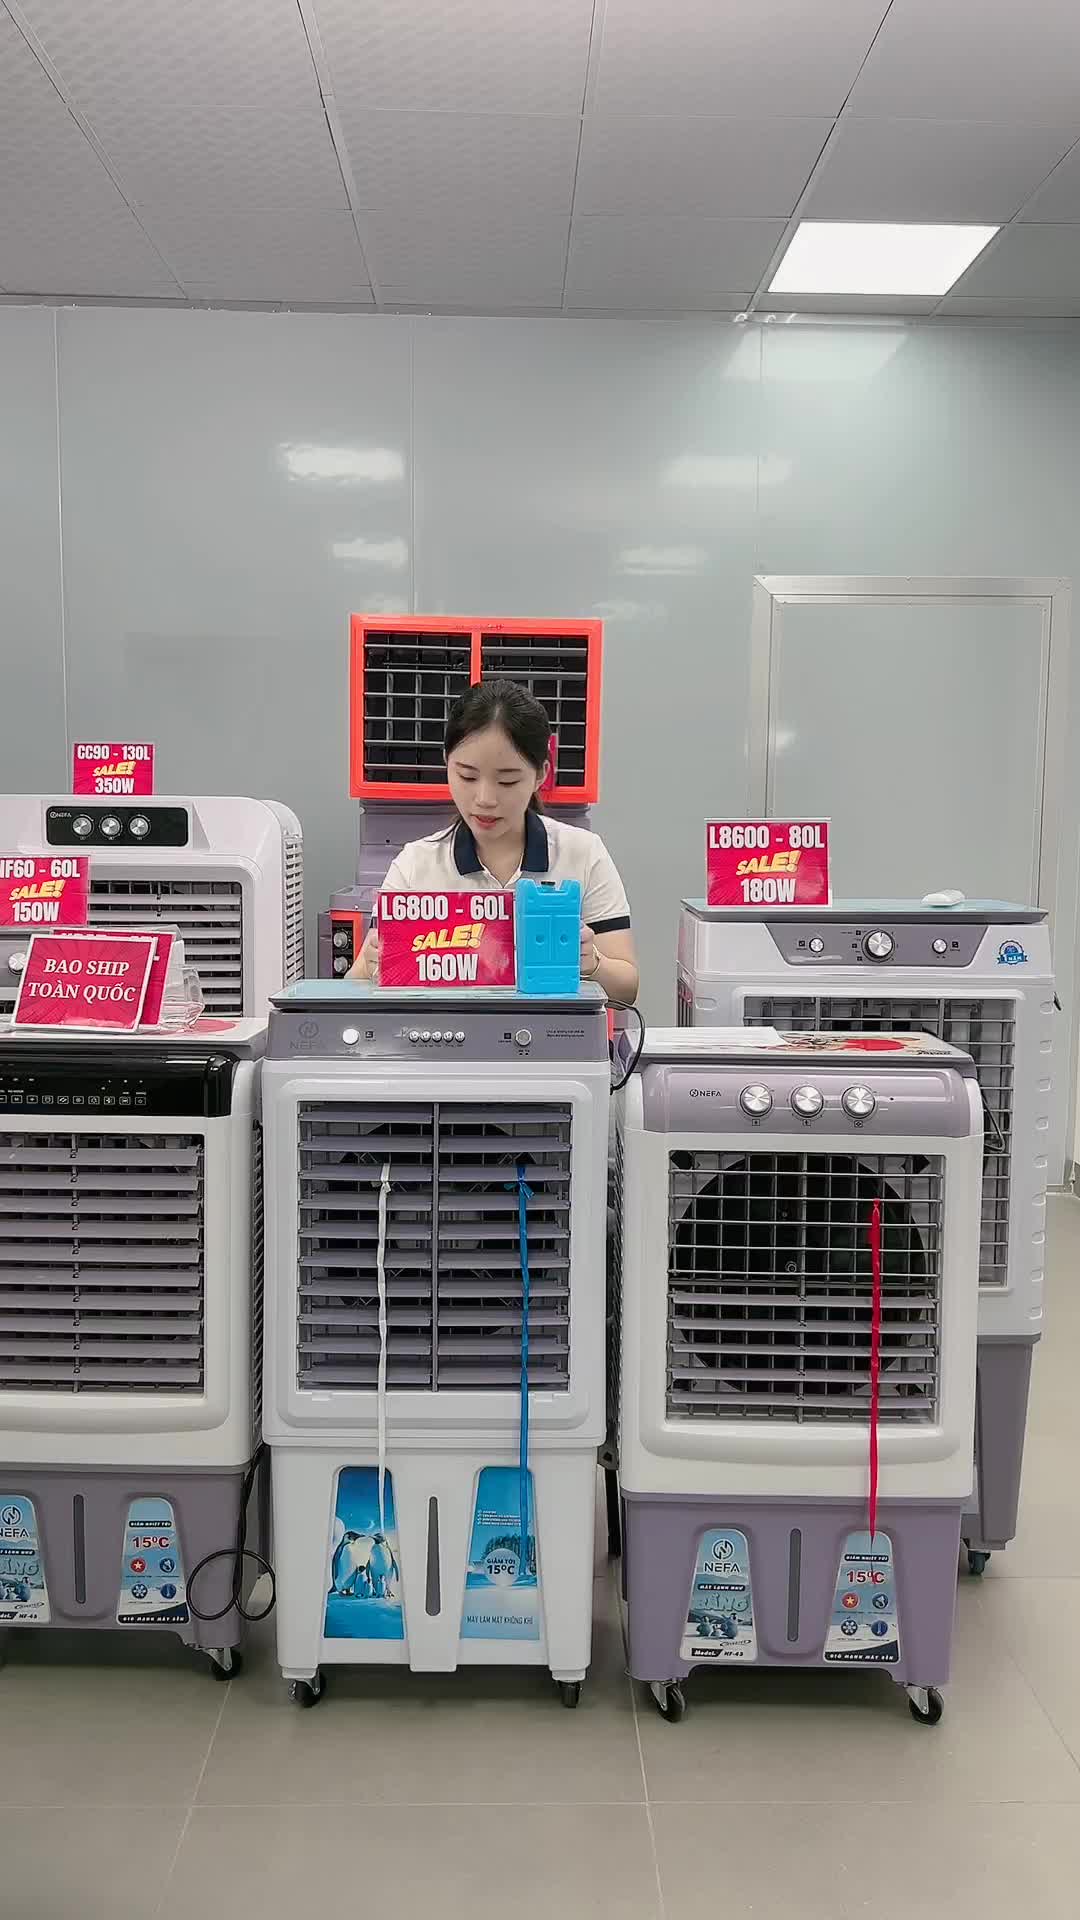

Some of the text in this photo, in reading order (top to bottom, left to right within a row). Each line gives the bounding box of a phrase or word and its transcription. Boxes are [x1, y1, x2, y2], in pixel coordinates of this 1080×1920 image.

[77, 745, 109, 760] CC90
[122, 745, 150, 760] 130L
[92, 761, 136, 776] SALE!
[95, 777, 134, 794] 350W
[709, 825, 769, 849] L8600
[789, 825, 825, 848] 80L
[51, 859, 80, 878] 60L
[736, 850, 801, 875] SALE!
[9, 879, 66, 900] SALE!
[741, 878, 796, 903] 180W
[12, 901, 60, 922] 150W
[381, 895, 448, 920] L6800
[470, 895, 509, 920] 60L
[411, 923, 486, 952] SALE!
[43, 958, 130, 976] BAO SHIP
[416, 953, 478, 981] 160W
[28, 980, 136, 1004] TOÀN QUỐC
[704, 1562, 740, 1573] NEFA
